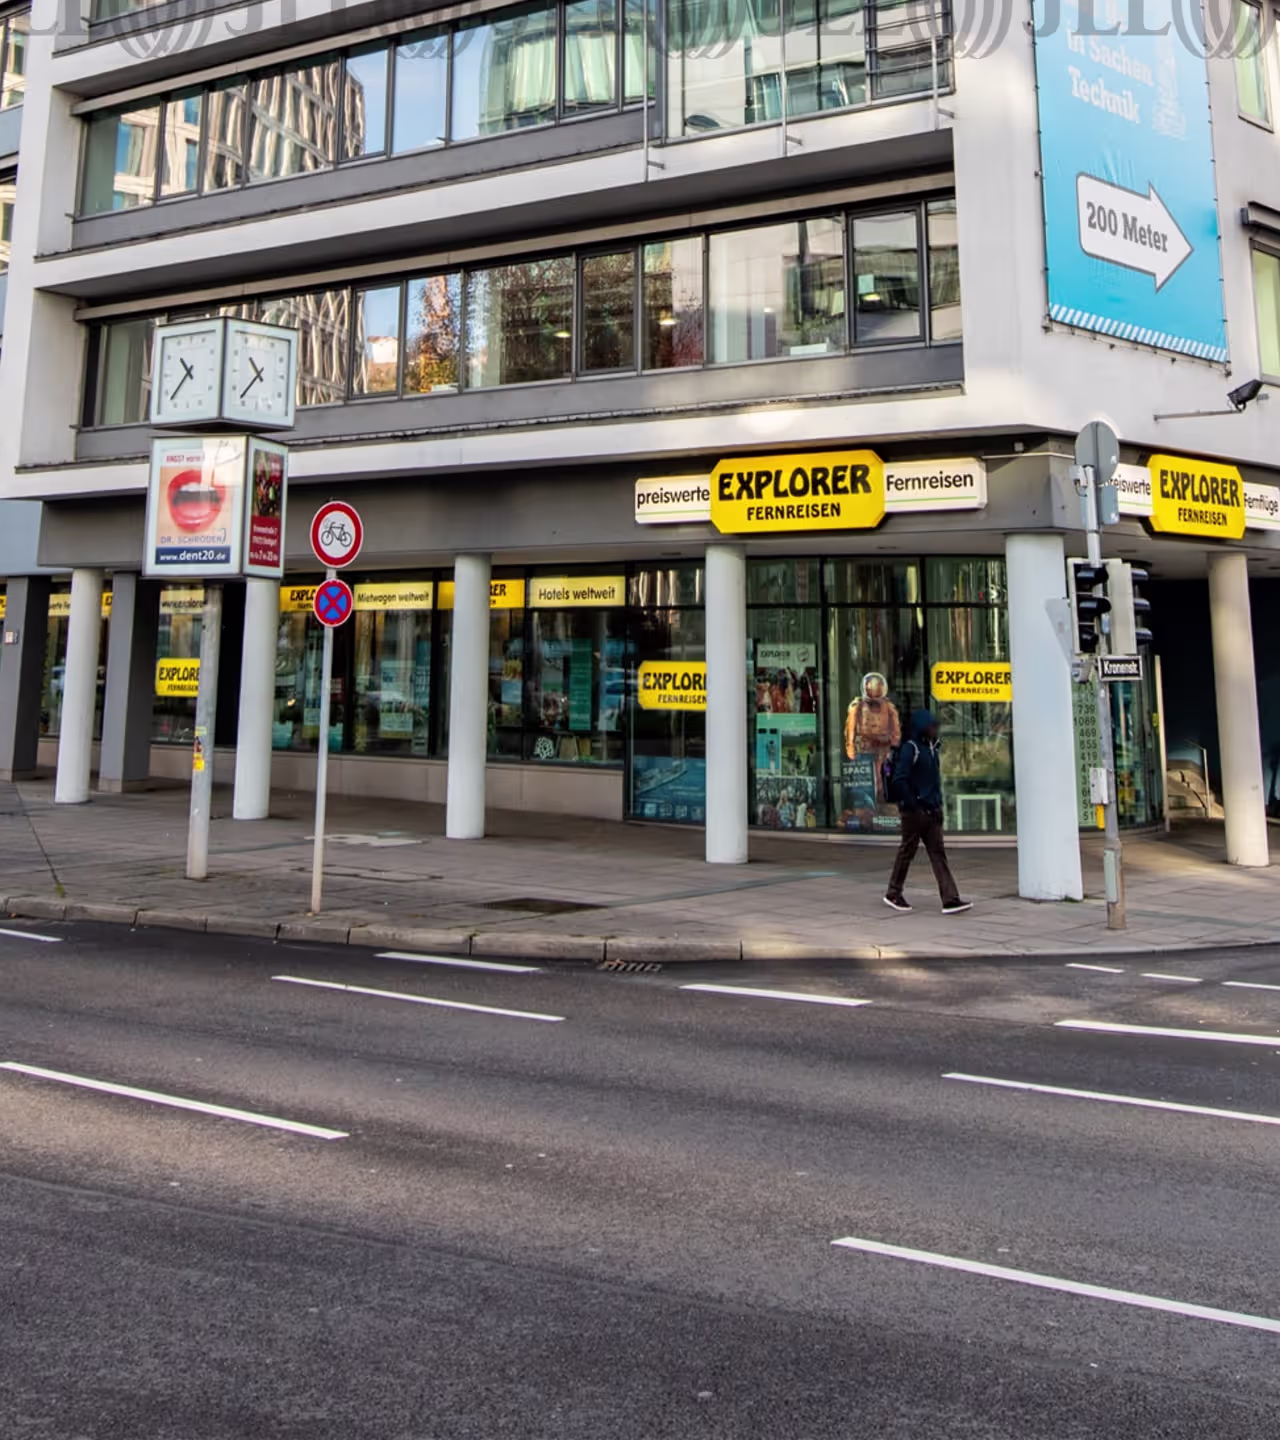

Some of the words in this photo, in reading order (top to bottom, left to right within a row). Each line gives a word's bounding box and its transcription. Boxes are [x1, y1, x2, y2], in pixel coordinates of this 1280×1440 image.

[1089, 33, 1154, 87] Sachen
[1068, 65, 1141, 124] Technik
[1086, 201, 1118, 236] 200
[1122, 211, 1169, 253] Meter
[718, 464, 872, 501] EXPLORER
[886, 470, 975, 492] Fernreisen
[1106, 474, 1152, 496] reiswerte
[1160, 469, 1240, 508] EXPLORER
[636, 486, 710, 509] preiswerte
[1244, 492, 1279, 516] Fernflüge
[747, 502, 842, 521] FERNREISEN
[1178, 507, 1228, 526] FERNREISEN
[160, 549, 226, 561] www.dent20.de
[289, 588, 316, 601] EXPLO
[358, 591, 396, 605] Mietwagen
[399, 590, 429, 602] weltweit
[538, 587, 570, 600] Hotels
[573, 585, 616, 600] weltweit
[159, 667, 200, 680] EXPLORE
[642, 672, 707, 691] EXPLOR
[935, 671, 1012, 684] EXPLORER
